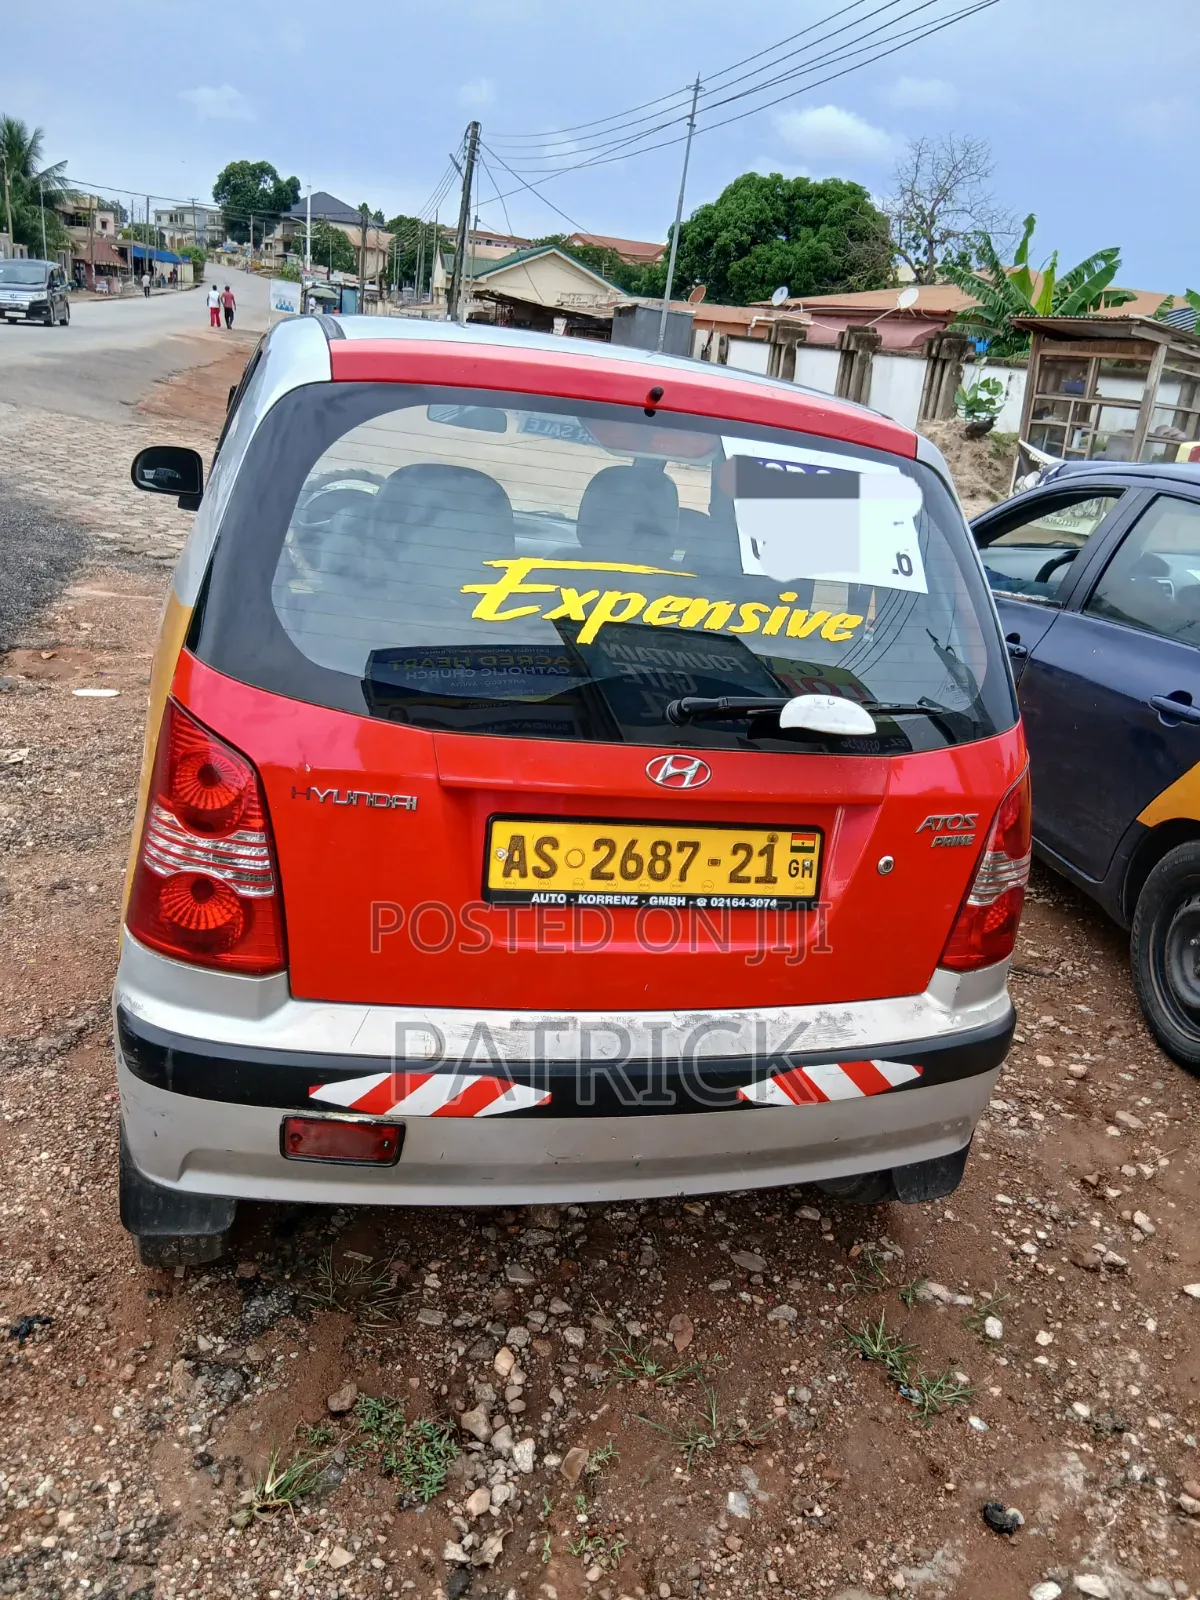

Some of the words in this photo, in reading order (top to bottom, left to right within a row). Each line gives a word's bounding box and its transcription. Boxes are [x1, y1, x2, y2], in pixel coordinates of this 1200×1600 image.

[460, 557, 863, 644] Expensive
[291, 786, 418, 811] HYUNDAI
[915, 813, 979, 833] ATOS
[931, 834, 976, 848] PRIME
[502, 835, 560, 879] AS
[788, 858, 814, 879] GH
[531, 893, 567, 904] AUTO
[578, 894, 639, 905] KORRENZ
[649, 896, 686, 907] GMBH
[710, 897, 778, 909] 02164-3074
